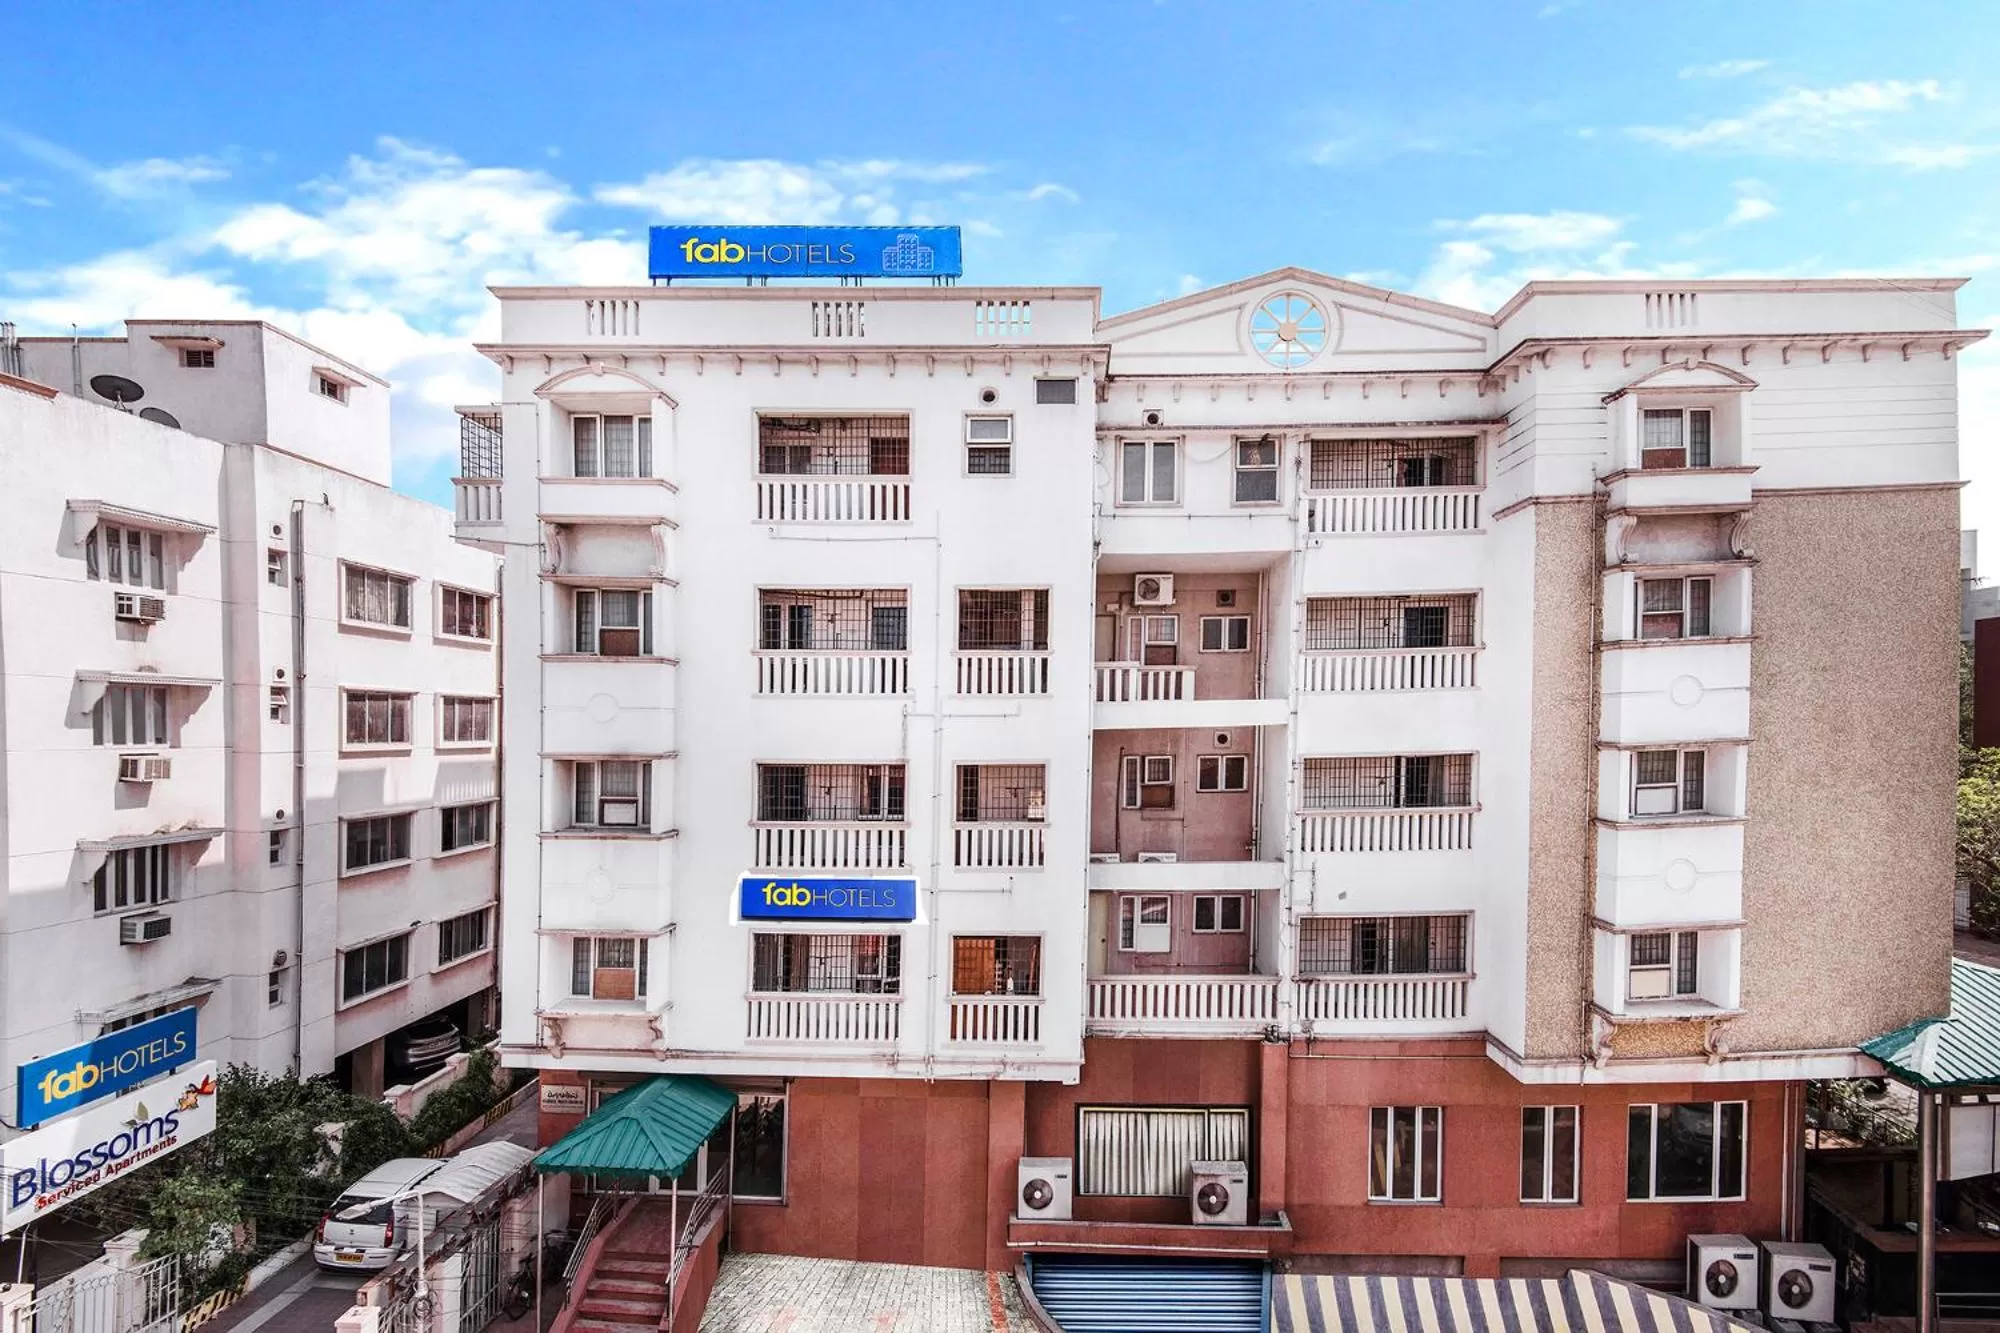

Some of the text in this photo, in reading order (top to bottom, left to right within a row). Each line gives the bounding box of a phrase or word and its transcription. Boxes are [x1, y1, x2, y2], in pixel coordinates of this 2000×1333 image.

[13, 1109, 180, 1208] Blossoms
[36, 1135, 177, 1209] Serviced Apartments
